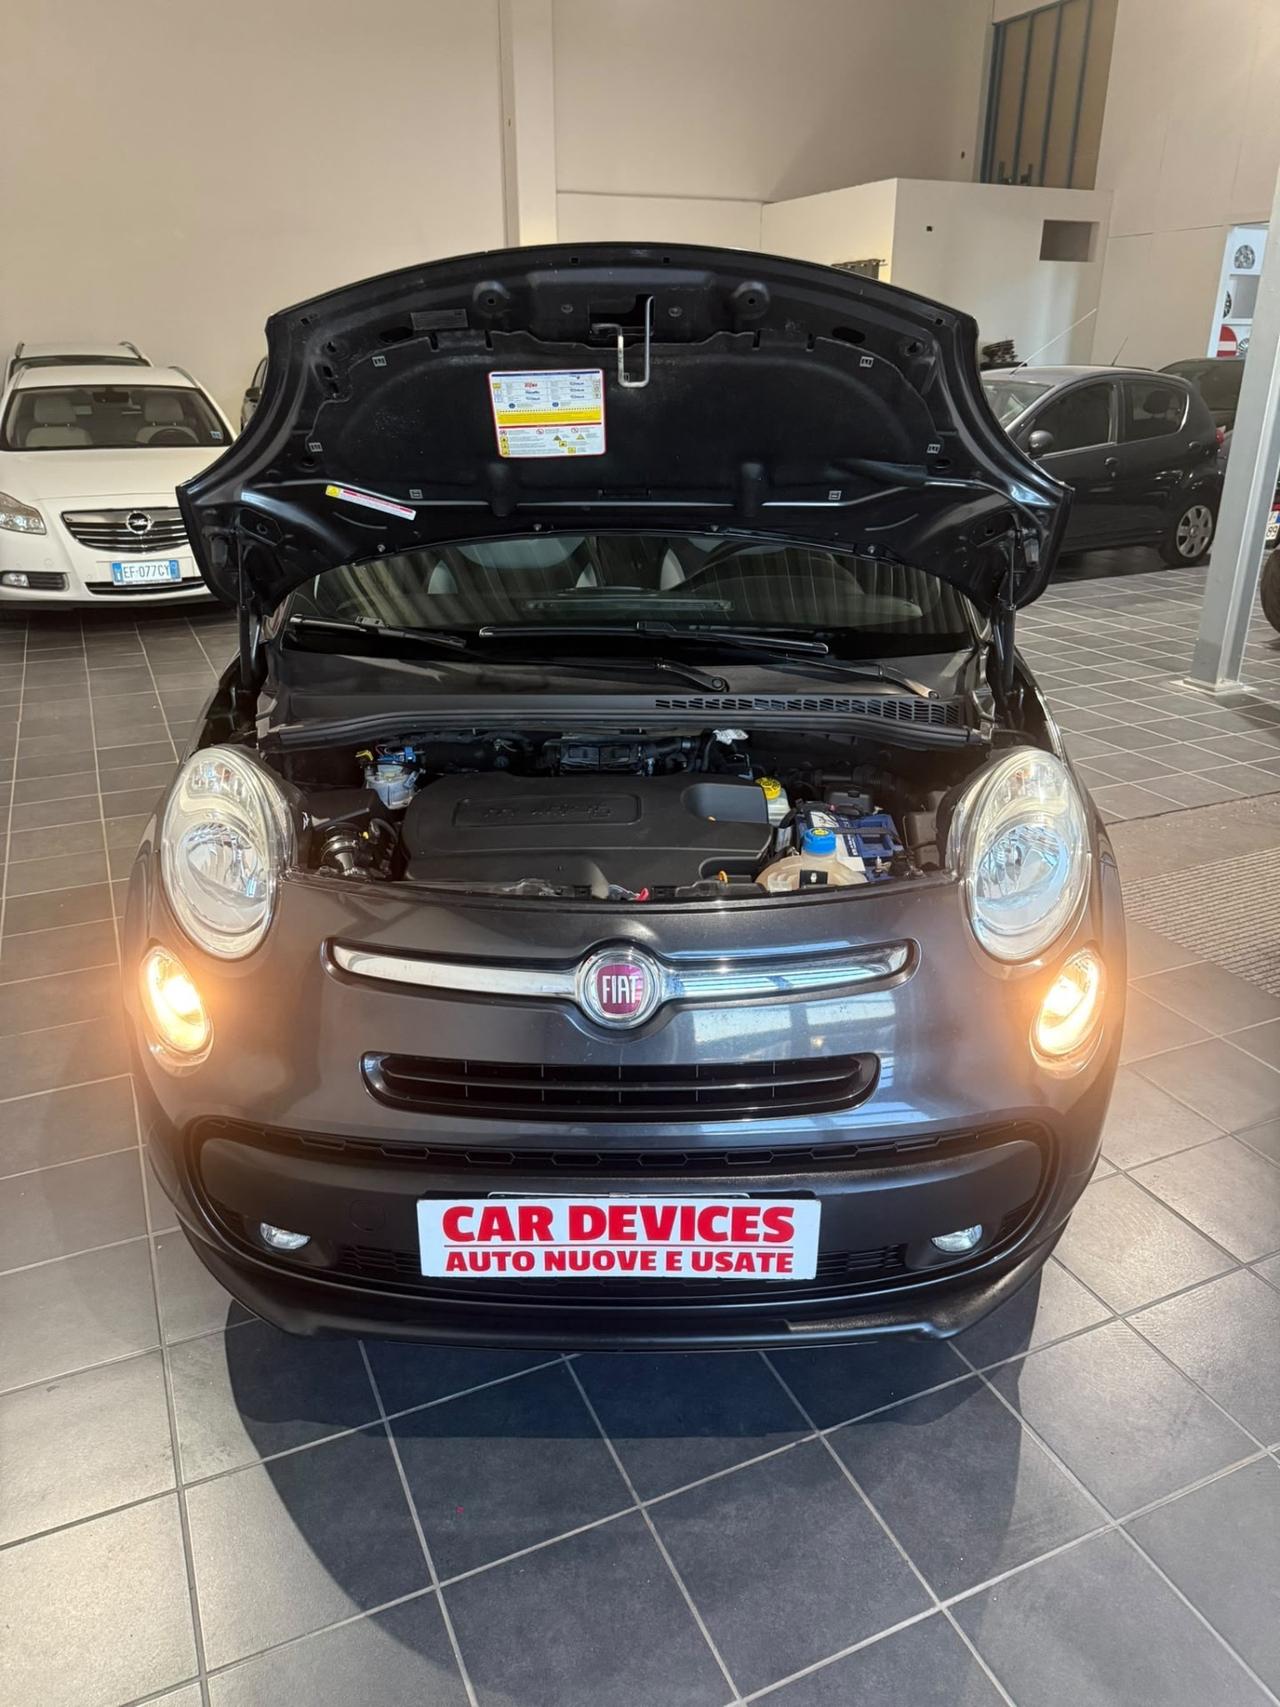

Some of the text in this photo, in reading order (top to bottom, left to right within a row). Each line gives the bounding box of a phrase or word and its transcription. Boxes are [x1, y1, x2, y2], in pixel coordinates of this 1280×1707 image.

[602, 975, 639, 1004] FIAT
[443, 1206, 795, 1243] CAR DEVICES
[446, 1251, 794, 1273] AUTO NUOVE E USATE
